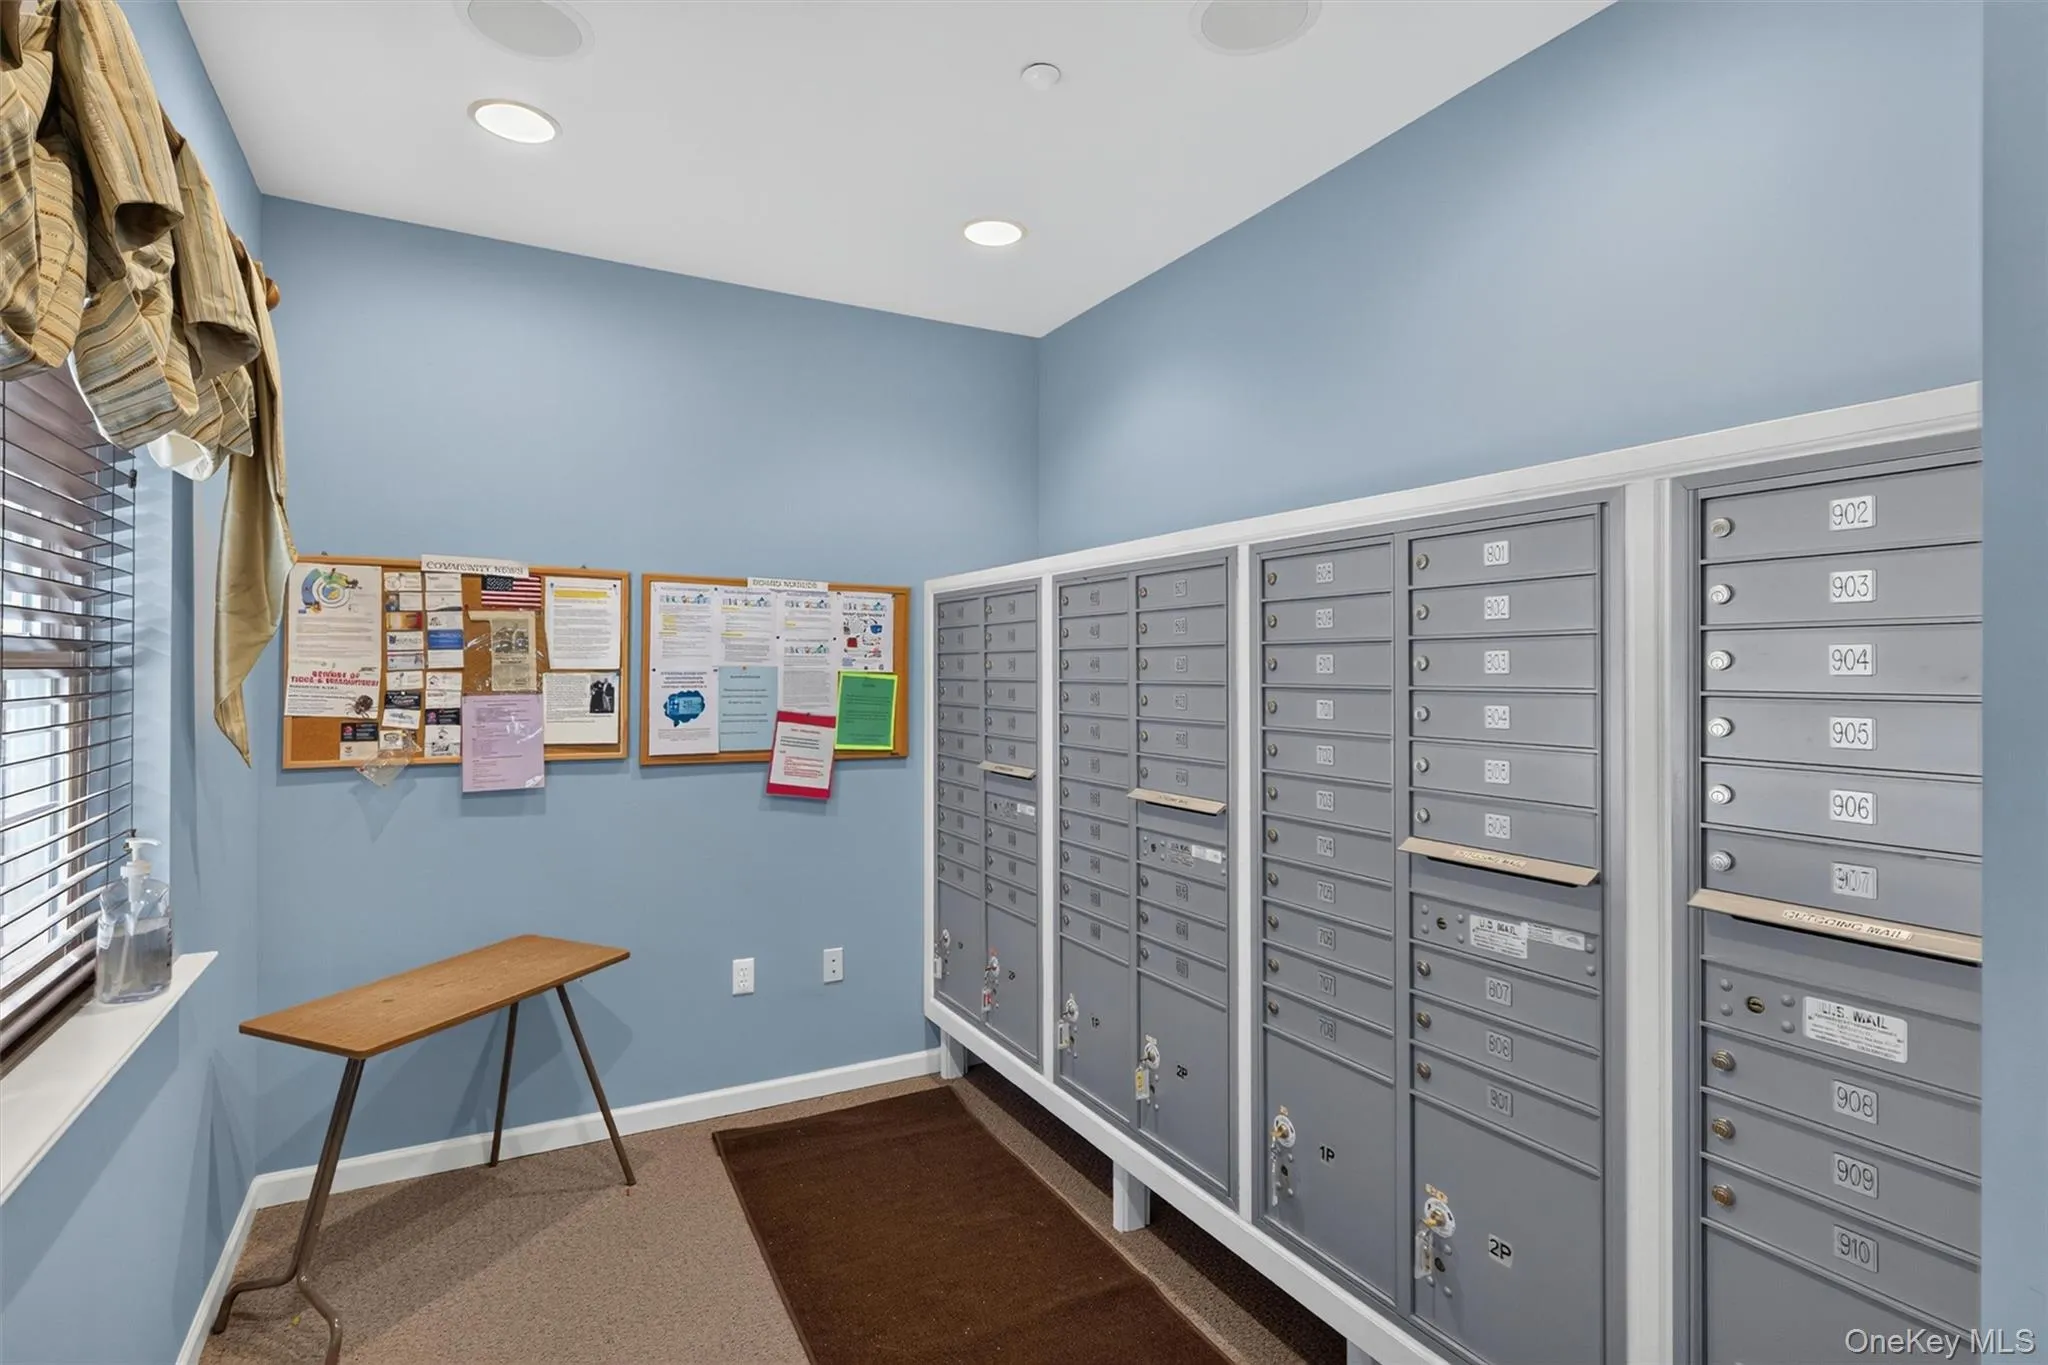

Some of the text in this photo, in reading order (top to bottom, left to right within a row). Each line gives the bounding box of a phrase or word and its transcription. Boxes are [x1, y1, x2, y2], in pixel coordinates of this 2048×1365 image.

[1832, 500, 1868, 525] 902
[1487, 545, 1504, 562] 801
[1832, 575, 1869, 599] 903
[1832, 649, 1870, 673] 904
[1832, 722, 1870, 746] 905
[1833, 794, 1870, 819] 906
[1852, 1010, 1889, 1030] MAIL
[1836, 1086, 1874, 1118] 908
[1320, 1145, 1335, 1163] 1P
[1836, 1160, 1874, 1191] 909
[1489, 1238, 1512, 1260] 2P
[1838, 1232, 1872, 1265] 910
